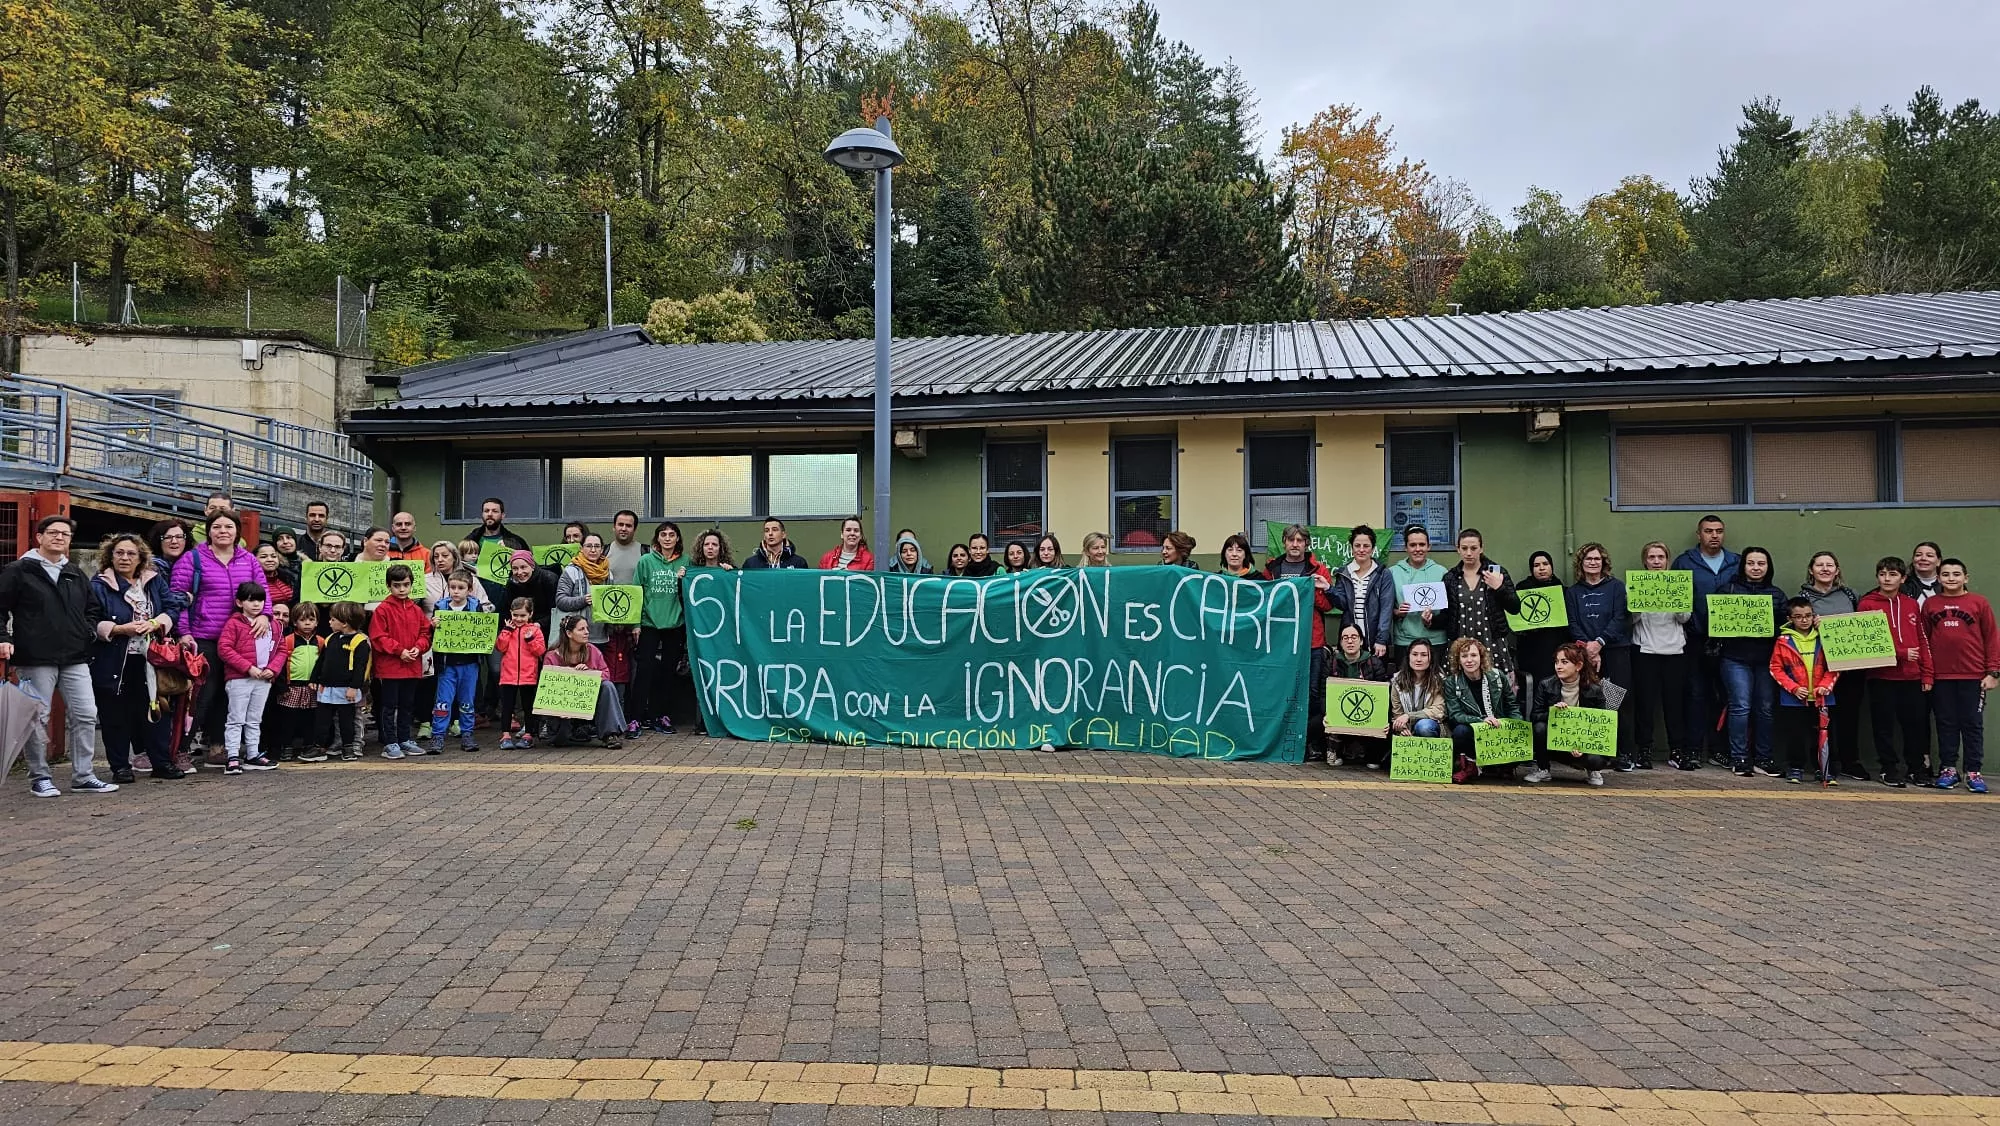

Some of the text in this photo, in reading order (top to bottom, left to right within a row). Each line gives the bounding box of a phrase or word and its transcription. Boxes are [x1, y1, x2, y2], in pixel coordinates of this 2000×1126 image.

[770, 608, 805, 643] LA
[1124, 602, 1162, 641] ES
[1169, 573, 1299, 655] CARA
[698, 658, 838, 721] PRUEBA
[844, 691, 890, 718] CON
[904, 693, 936, 718] LA
[1029, 724, 1053, 744] DE
